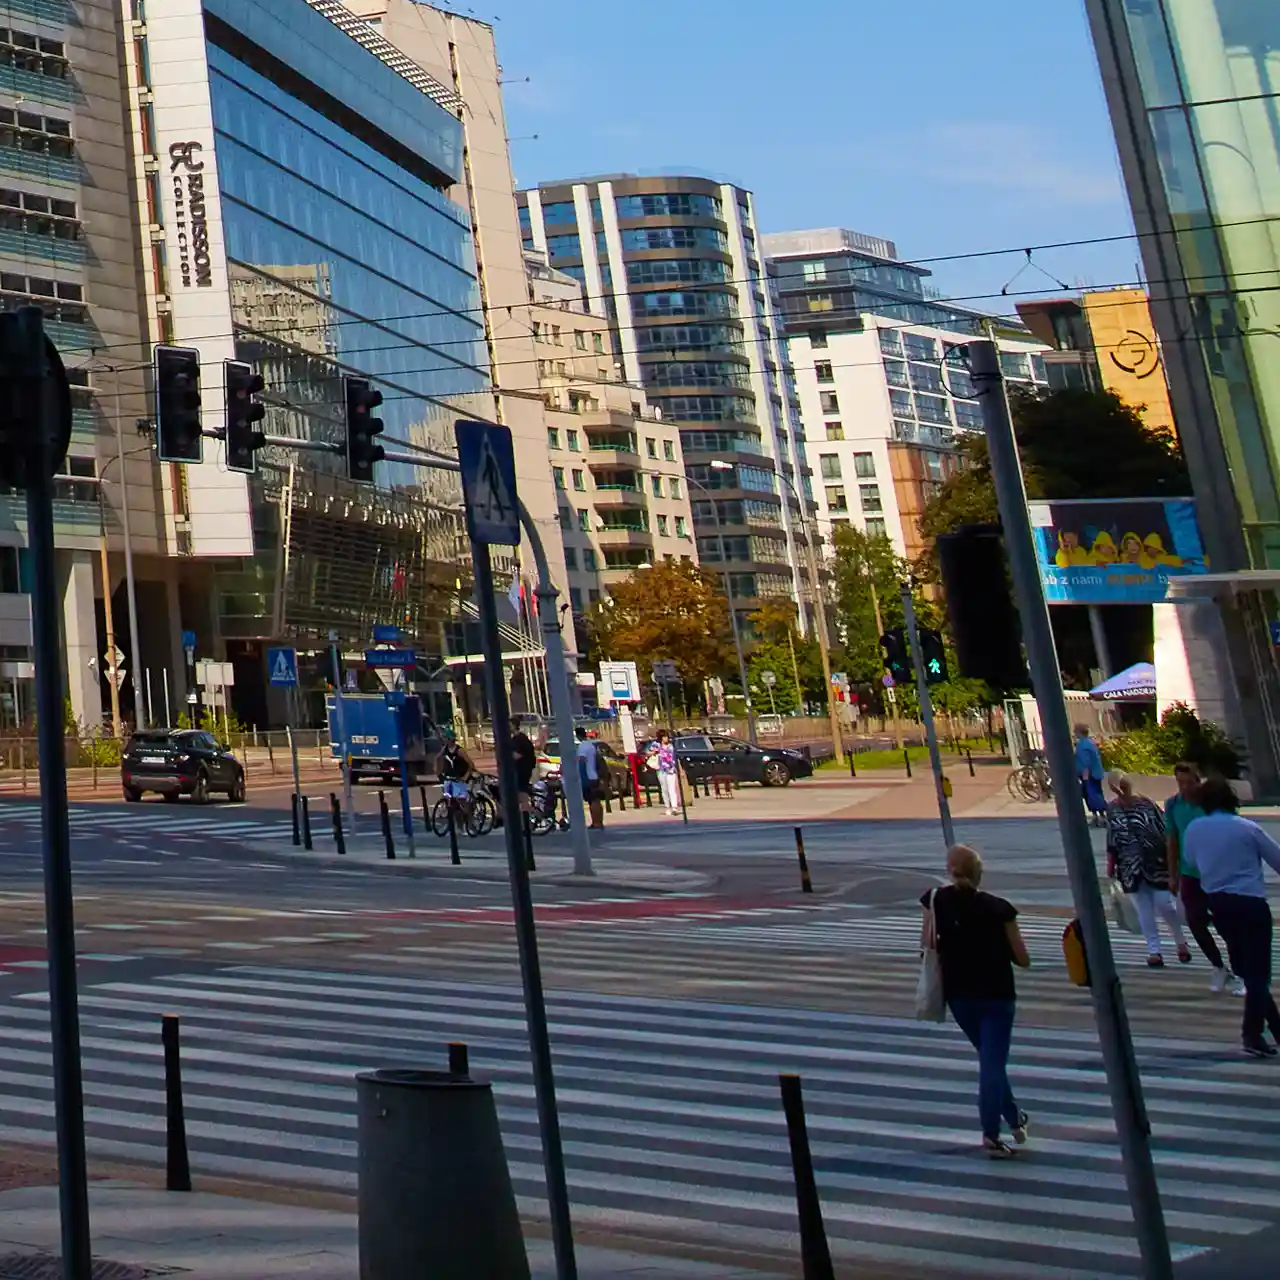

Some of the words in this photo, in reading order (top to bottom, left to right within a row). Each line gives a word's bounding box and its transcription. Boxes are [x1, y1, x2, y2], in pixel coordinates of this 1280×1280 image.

[173, 175, 191, 288] COLLECTION
[187, 173, 212, 287] RADISSON
[1072, 574, 1102, 586] nami
